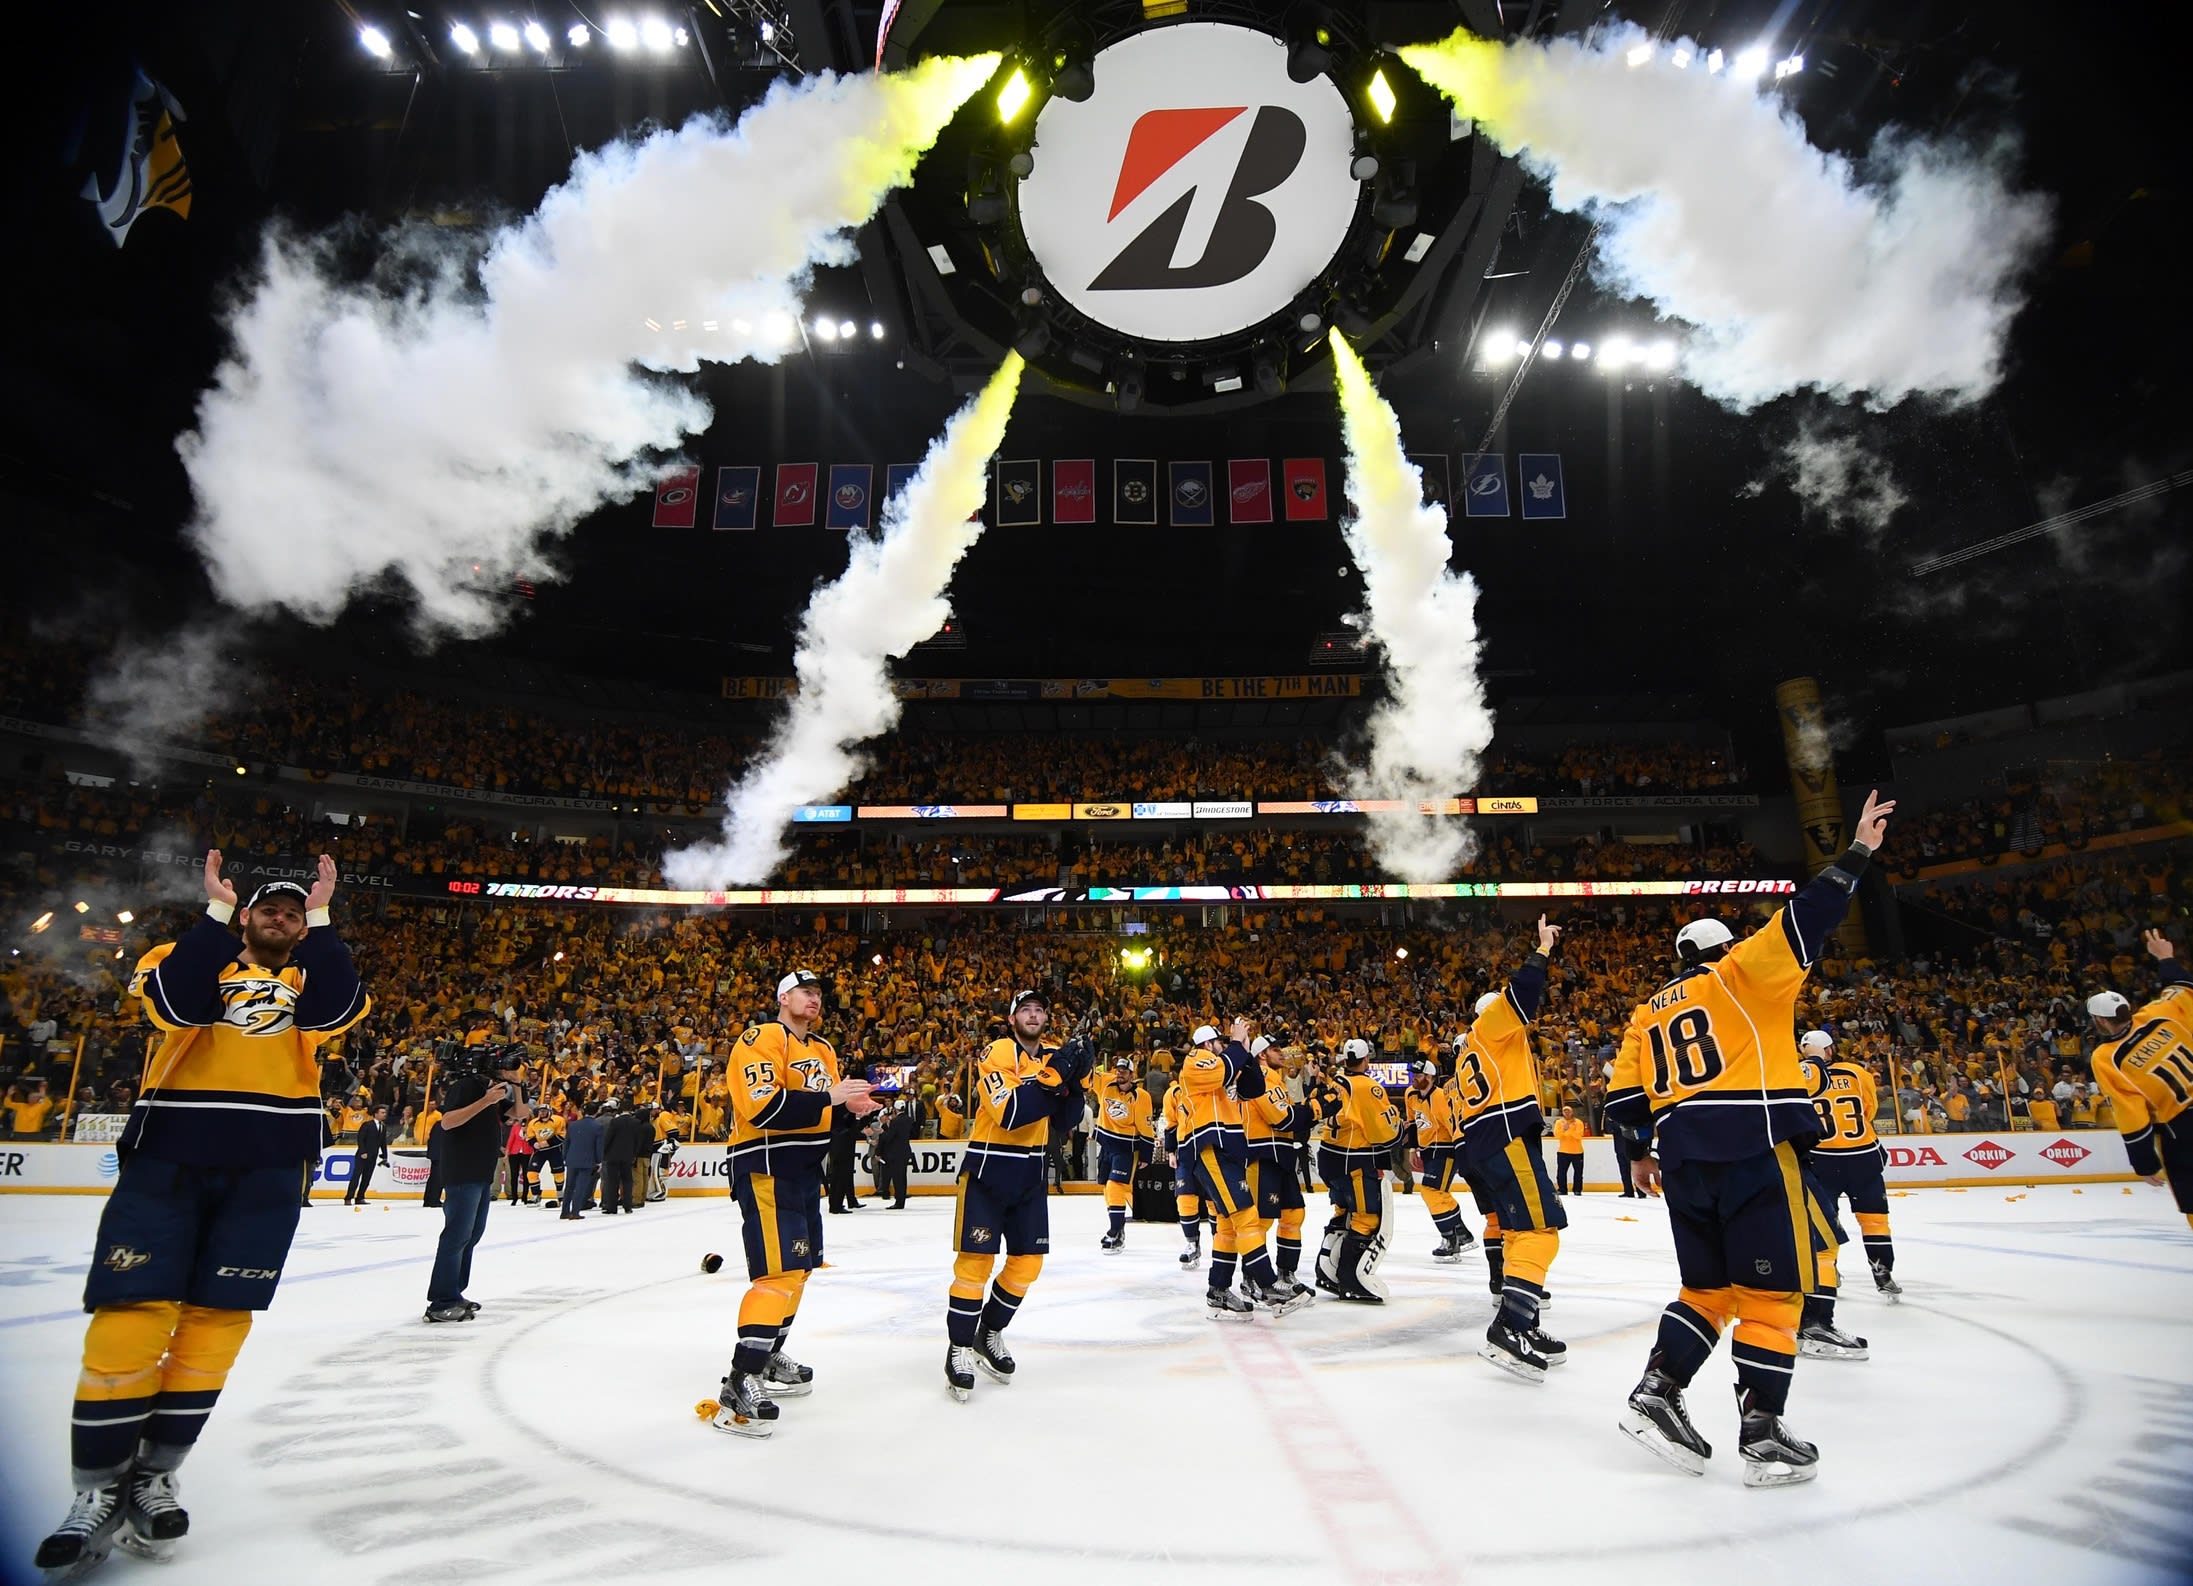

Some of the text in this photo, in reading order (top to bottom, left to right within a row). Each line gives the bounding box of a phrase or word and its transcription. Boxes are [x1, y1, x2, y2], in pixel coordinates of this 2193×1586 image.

[1203, 680, 1224, 696] BE
[1232, 679, 1265, 696] THE
[1307, 676, 1348, 694] MAN
[356, 777, 408, 792] GARY
[415, 784, 477, 799] FORCE
[502, 795, 556, 807] ACURA
[1583, 798, 1633, 807] FORCE
[1653, 797, 1703, 806] ACURA
[1708, 796, 1756, 805] LEVEL
[817, 809, 840, 818] AT&T
[1090, 807, 1114, 816] Ford
[1196, 806, 1251, 815] BRIDGESTONE
[64, 840, 132, 859] GARY
[141, 851, 206, 867] FORC
[448, 882, 480, 894] 10:02
[1651, 984, 1687, 1013] NEAL
[1648, 1009, 1722, 1094] 18
[2128, 1028, 2176, 1068] EKHOLM
[744, 1062, 774, 1087] 55
[983, 1071, 1003, 1094] 19
[1456, 1051, 1492, 1108] 3
[1969, 1148, 2008, 1162] ORKIN
[2046, 1147, 2084, 1160] ORKIN
[215, 1265, 279, 1280] CCM
